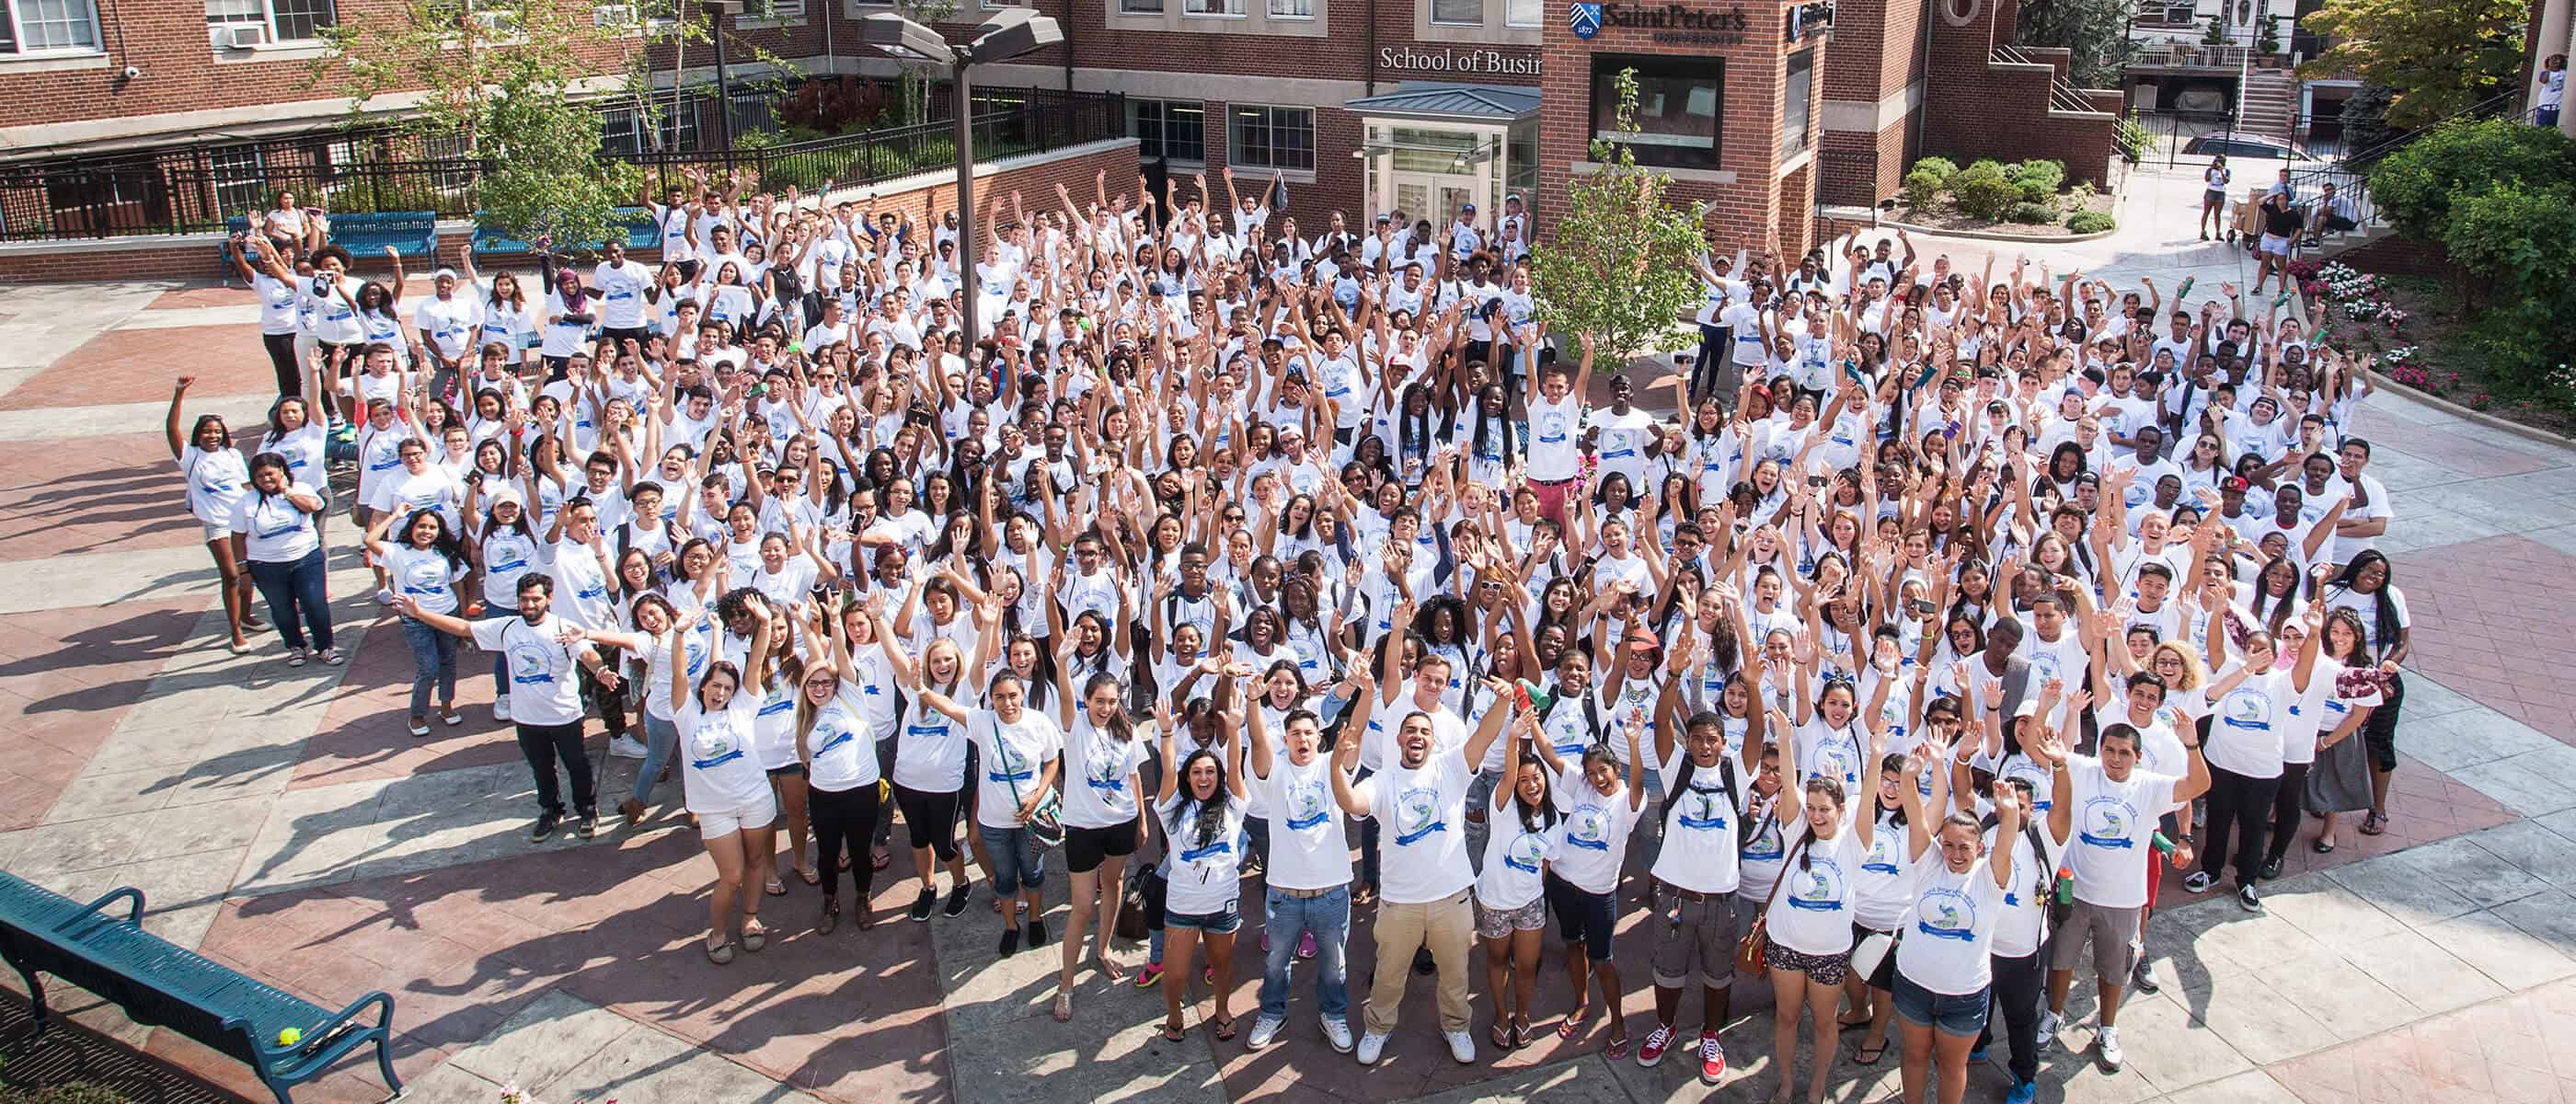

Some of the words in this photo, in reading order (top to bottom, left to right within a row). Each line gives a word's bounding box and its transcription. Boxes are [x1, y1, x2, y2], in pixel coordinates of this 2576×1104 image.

[1578, 26, 1593, 35] 1872
[1381, 47, 1451, 71] School
[1457, 50, 1484, 72] of
